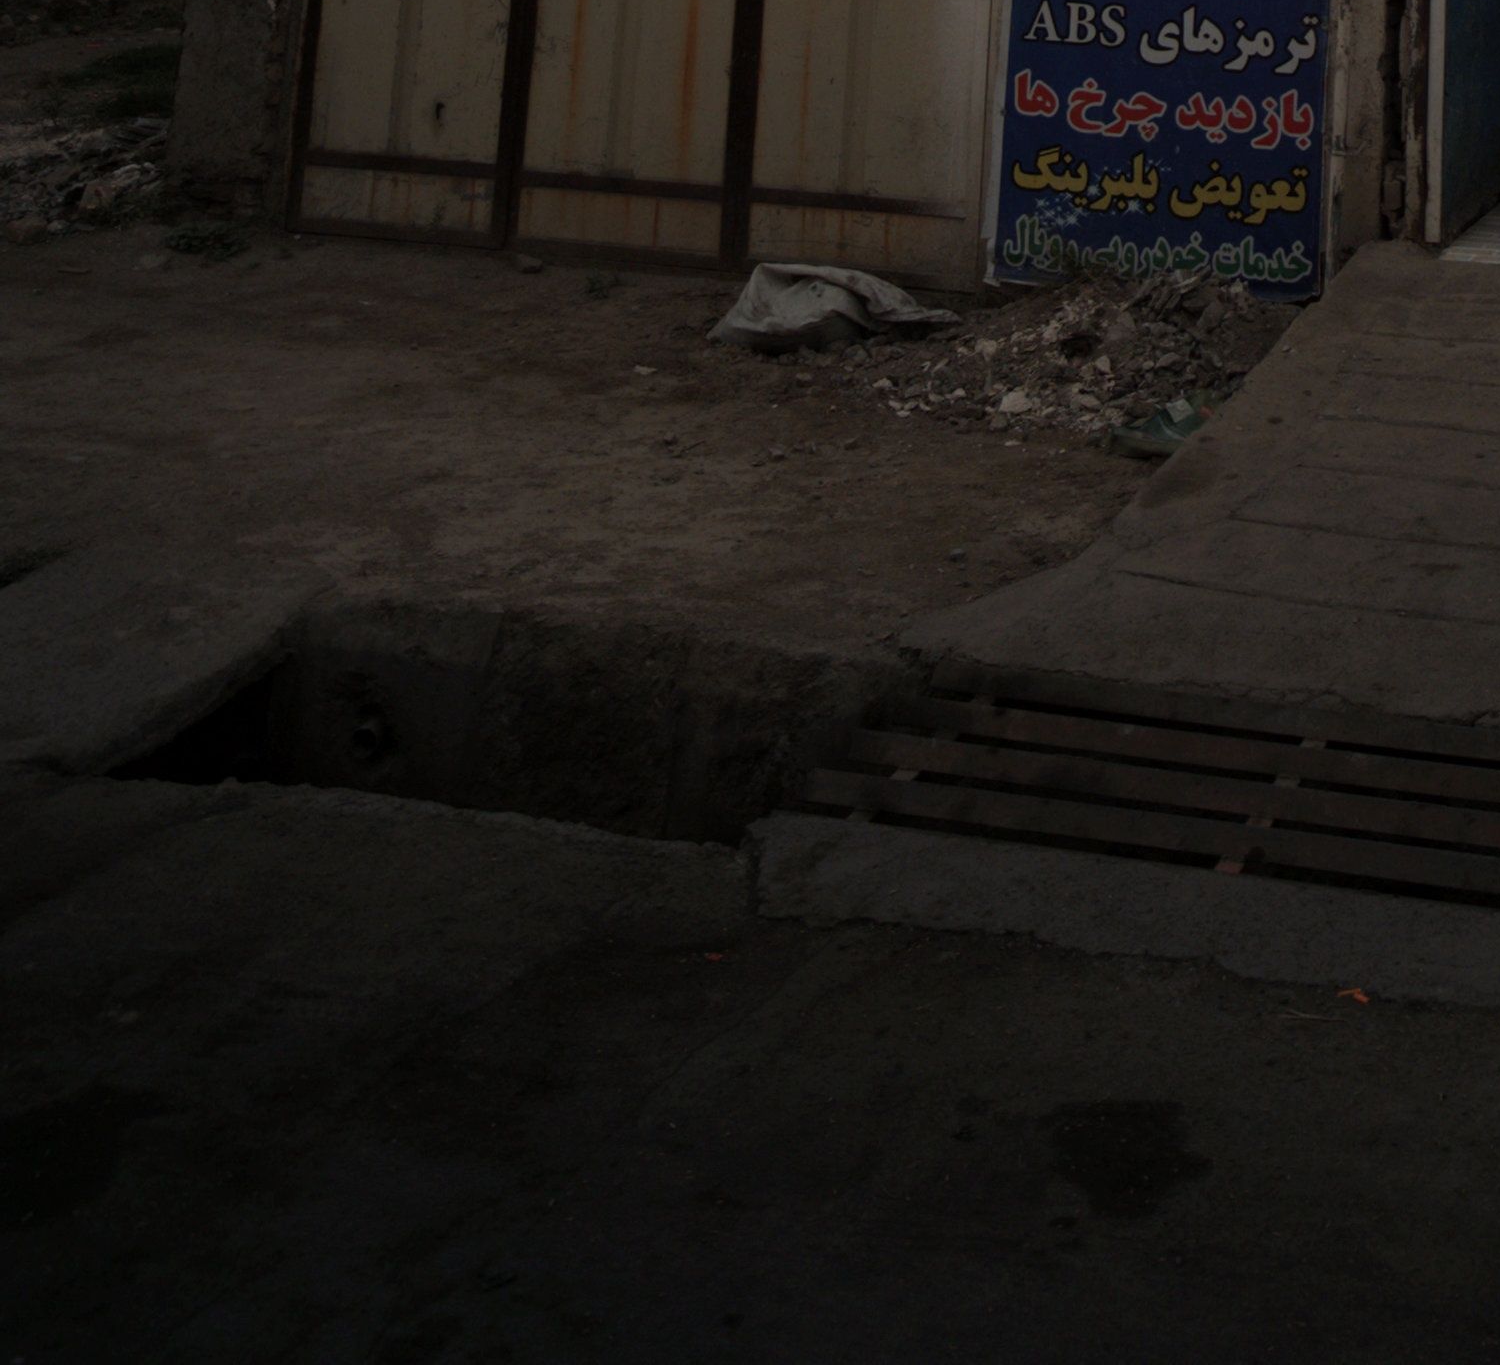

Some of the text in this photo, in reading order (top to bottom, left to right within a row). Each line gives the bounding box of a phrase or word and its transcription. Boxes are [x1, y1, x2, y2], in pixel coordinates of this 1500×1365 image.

[1023, 0, 1128, 49] ABS
[1013, 70, 1315, 150] بازدید چرخ ها
[1011, 144, 1310, 227] تعویض بلبرینگ
[1211, 234, 1313, 284] خدمات
